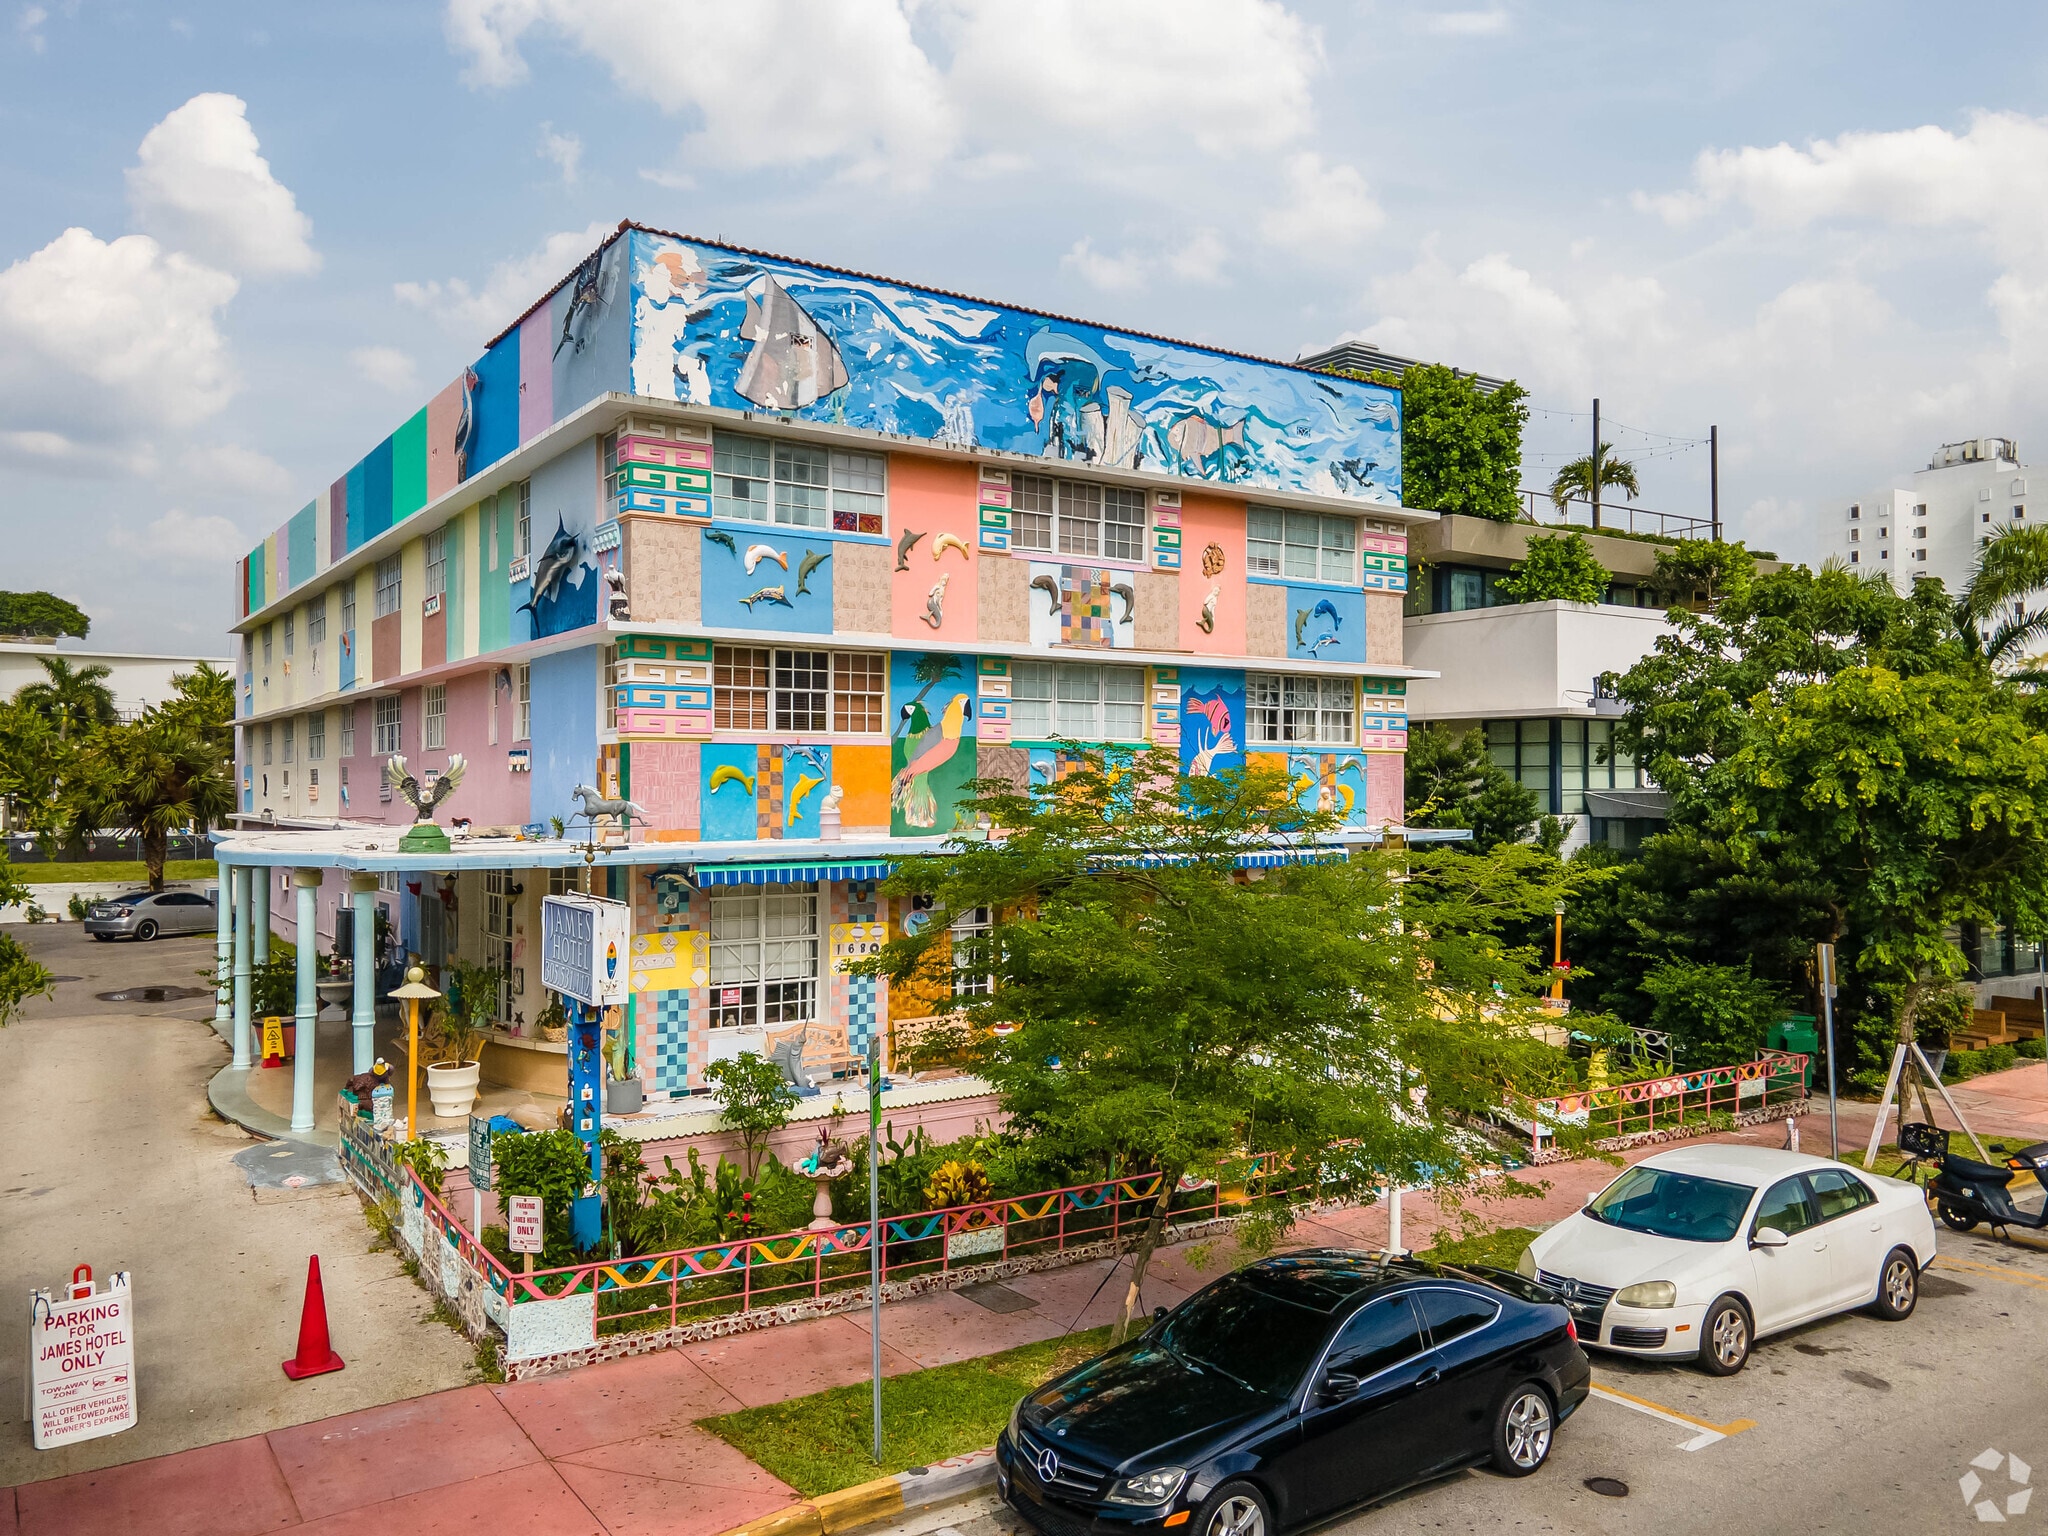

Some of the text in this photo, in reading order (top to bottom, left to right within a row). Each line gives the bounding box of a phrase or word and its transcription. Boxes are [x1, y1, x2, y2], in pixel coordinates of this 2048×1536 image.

[549, 904, 591, 942] JAMES
[552, 934, 589, 971] HOTEL
[837, 943, 879, 955] 1680
[517, 1226, 534, 1235] ONLY
[45, 1303, 120, 1331] PARKING
[69, 1323, 95, 1338] FOR
[40, 1331, 126, 1361] JAMES HOTEL
[61, 1350, 105, 1372] ONLY
[41, 1380, 89, 1395] TOW-AWAY
[53, 1389, 77, 1399] ZONE
[42, 1394, 127, 1419] ALL OTHER VEHICLES
[43, 1403, 129, 1429] WILL BE TOWED AWAY
[43, 1411, 130, 1438] AT OWNER'S EXPENSE
